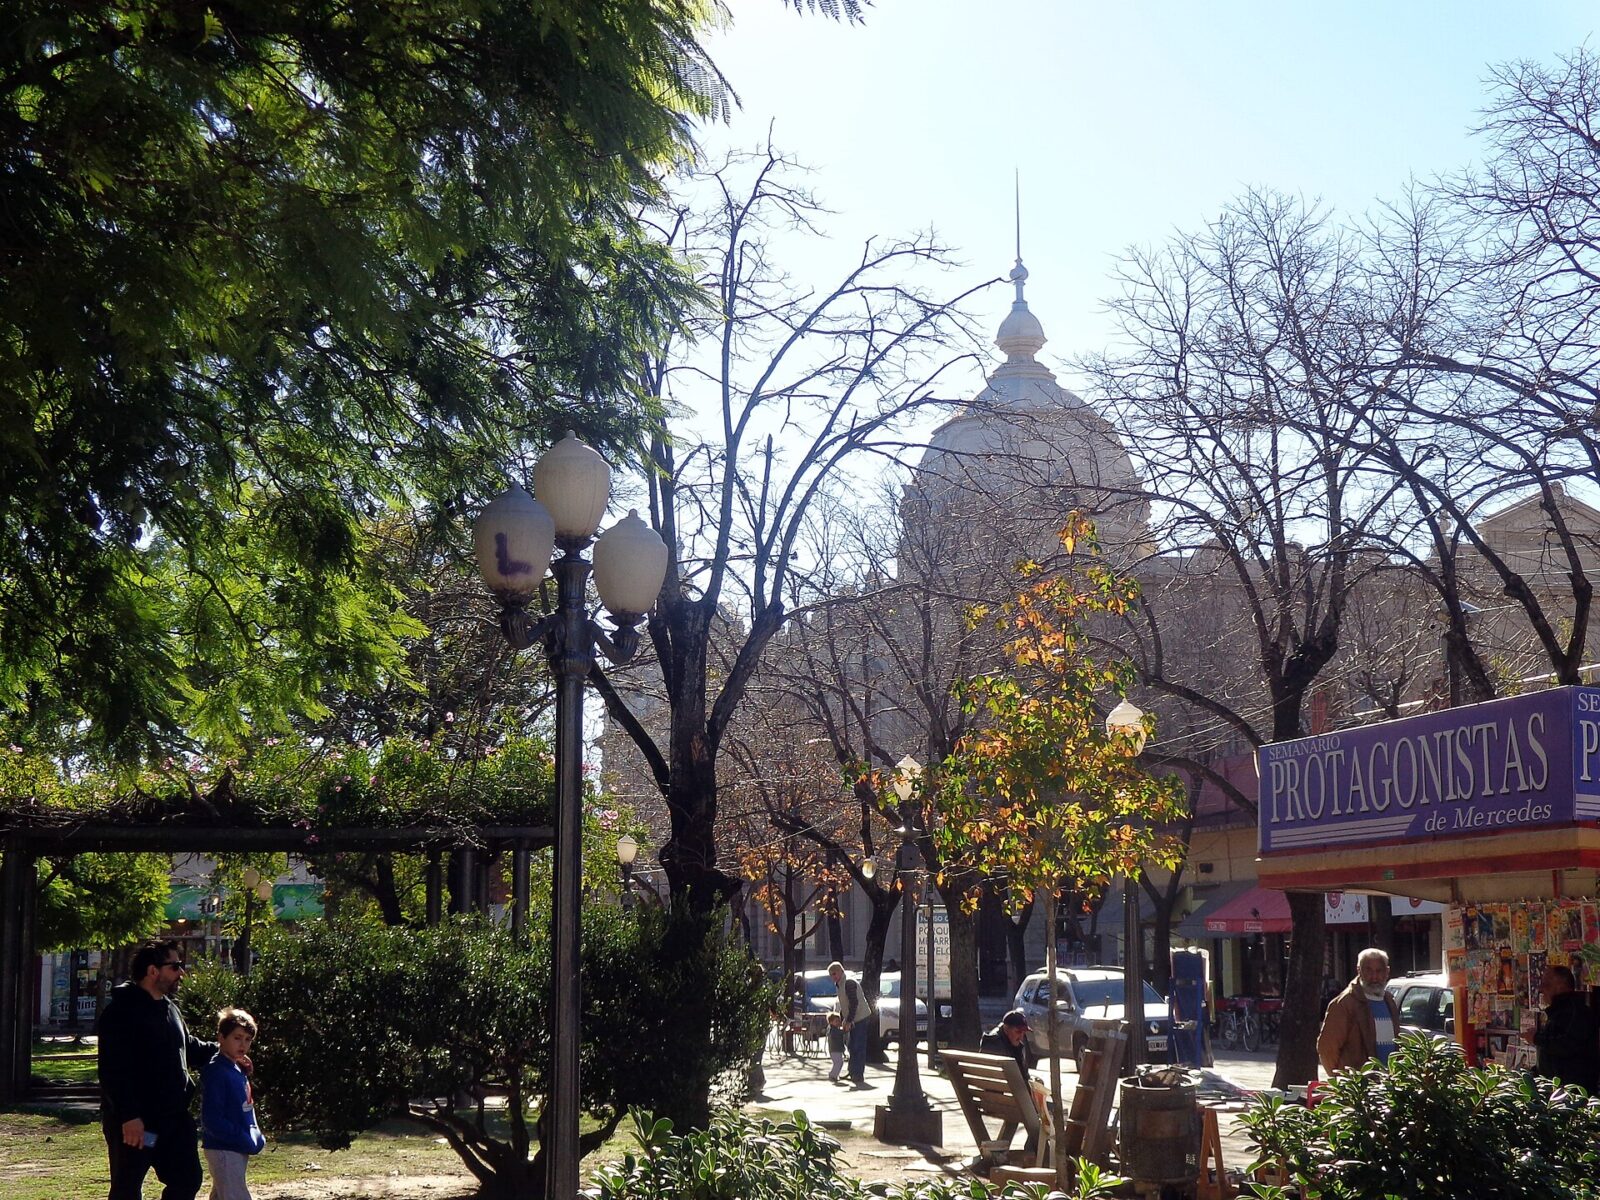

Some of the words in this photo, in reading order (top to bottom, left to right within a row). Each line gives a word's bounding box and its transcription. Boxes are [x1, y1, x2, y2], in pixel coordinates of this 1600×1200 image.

[1268, 735, 1341, 761] SEMANARIO
[1269, 712, 1549, 823] PROTAGONISTAS
[1580, 719, 1600, 782] P
[1424, 810, 1447, 832] de
[1452, 798, 1552, 829] Mercedes
